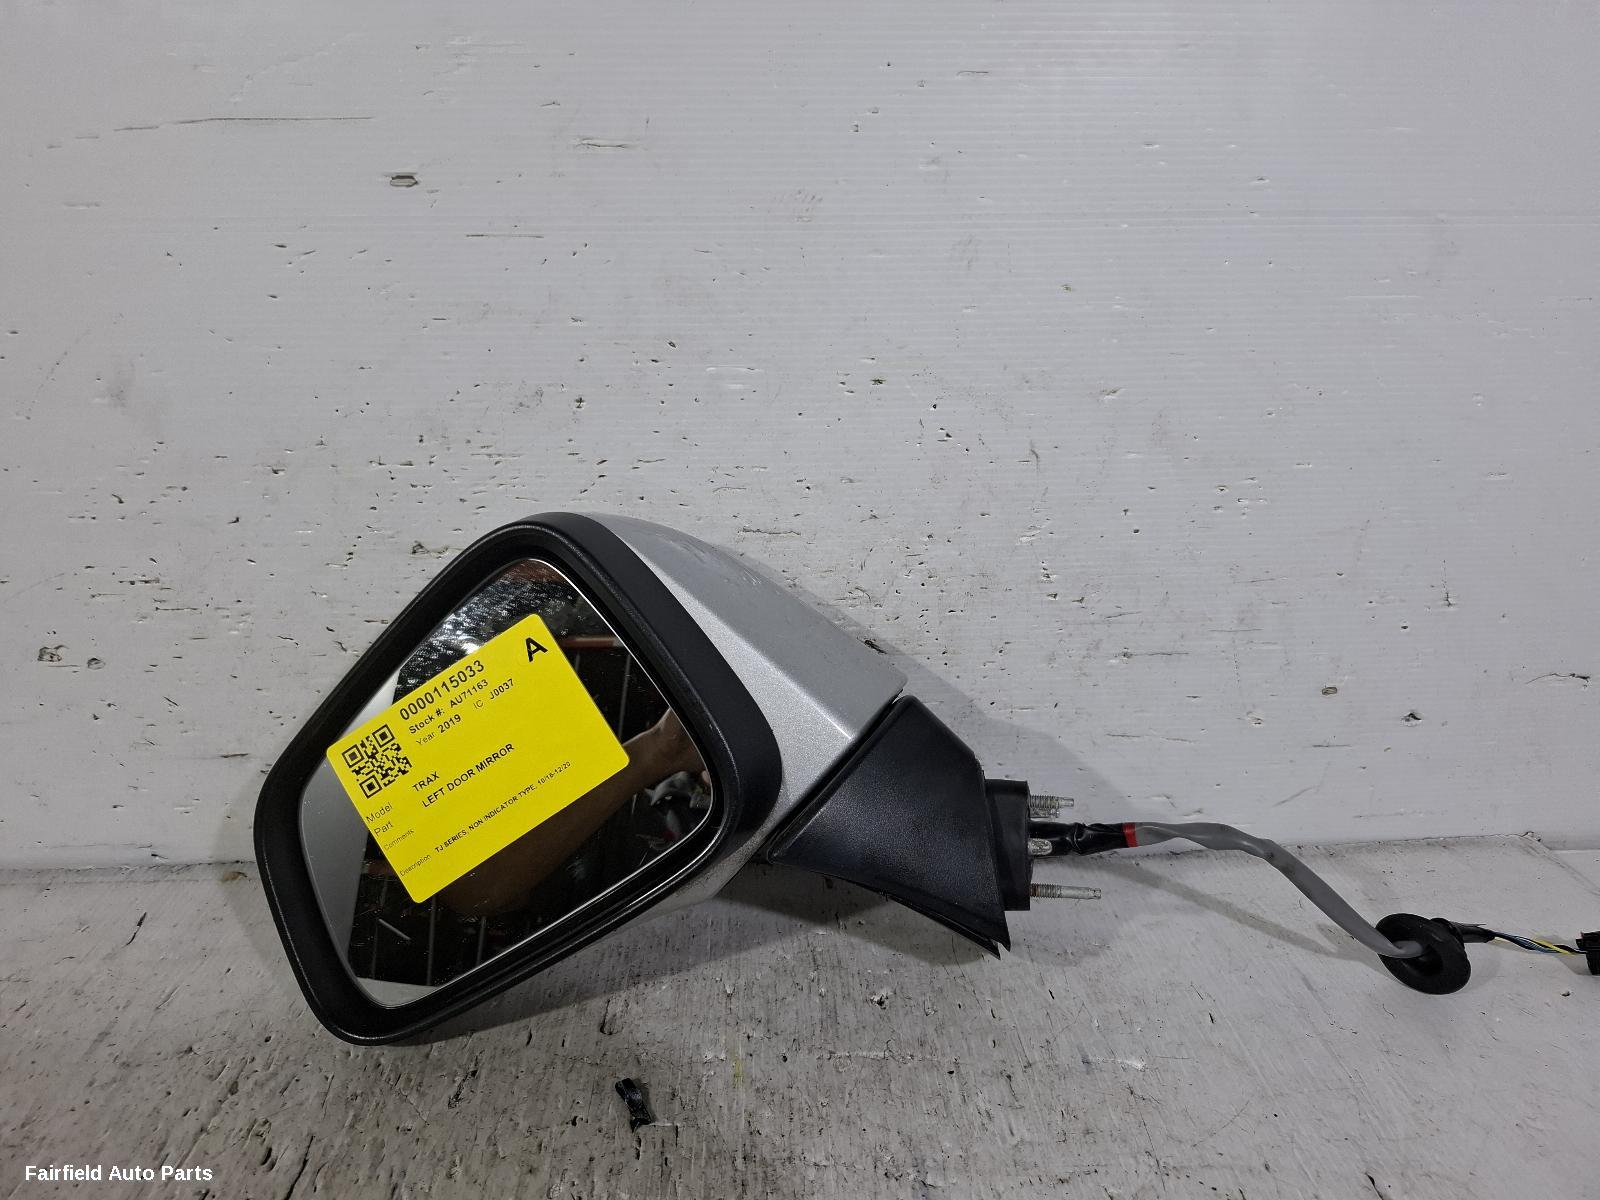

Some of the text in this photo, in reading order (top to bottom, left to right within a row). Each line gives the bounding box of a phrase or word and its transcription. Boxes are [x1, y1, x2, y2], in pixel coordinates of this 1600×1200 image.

[525, 637, 548, 662] A
[400, 660, 485, 720] 0000115033
[409, 714, 434, 734] Stock
[450, 679, 488, 708] AU71163
[416, 678, 515, 745] Year 2019 IC J0037
[366, 771, 440, 823] Model TRAX
[374, 743, 515, 837] Part LEFT DOOR MIRROR
[384, 829, 414, 851] Comments
[400, 854, 432, 877] Description
[434, 844, 444, 853] TJ
[468, 818, 484, 831] NON
[483, 796, 519, 821] INDICATOR
